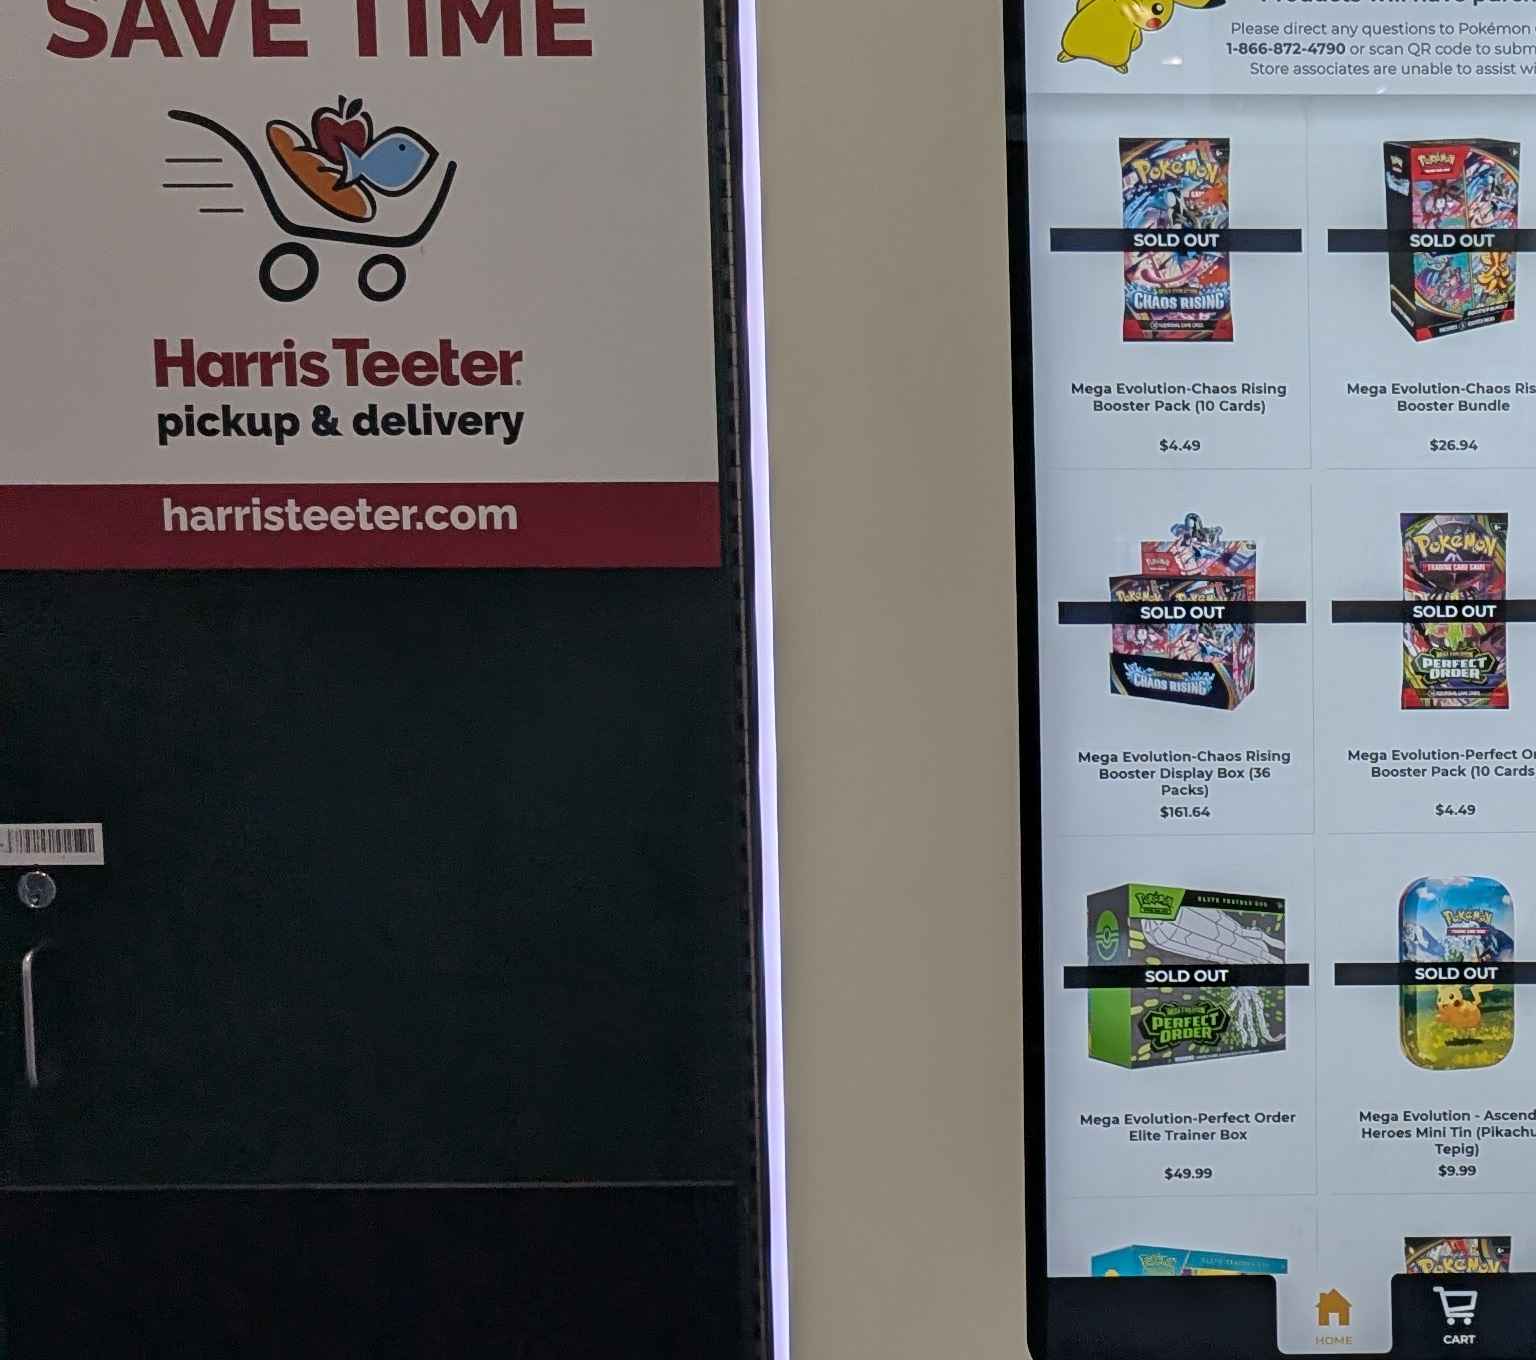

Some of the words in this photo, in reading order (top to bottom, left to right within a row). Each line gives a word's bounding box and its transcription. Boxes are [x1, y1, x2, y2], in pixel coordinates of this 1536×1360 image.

[1231, 21, 1280, 36] Please
[1283, 21, 1328, 36] direct
[1330, 23, 1359, 39] any
[1361, 21, 1436, 38] questions
[1439, 23, 1455, 36] to
[1458, 21, 1531, 36] Pokémon
[1225, 41, 1346, 56] 1-866-872-4790
[1349, 44, 1366, 56] or
[1368, 44, 1404, 56] scan
[1407, 42, 1432, 58] QR
[1434, 41, 1473, 56] code
[1475, 43, 1491, 56] to
[1249, 61, 1290, 76] Store
[1292, 61, 1370, 76] associates
[1373, 64, 1397, 76] are
[1401, 61, 1454, 76] unable
[1455, 63, 1473, 76] to
[1475, 61, 1517, 76] assist
[1133, 233, 1181, 248] SOLD
[1183, 233, 1220, 248] OUT
[1409, 233, 1457, 248] SOLD
[1459, 233, 1496, 248] OUT
[1134, 292, 1178, 310] CHAOS
[1180, 292, 1224, 310] RISING
[153, 338, 330, 388] Harris
[331, 337, 523, 387] Teeter
[1071, 382, 1113, 398] Mega
[1116, 381, 1238, 395] Evolution-Chaos
[1241, 382, 1287, 398] Rising
[1347, 383, 1388, 398] Mega
[1391, 382, 1511, 395] Evolution-Chaos
[1093, 399, 1151, 412] Booster
[1154, 399, 1191, 412] Pack
[1195, 399, 1215, 415] (10
[1218, 399, 1266, 415] Cards)
[1397, 399, 1455, 412] Booster
[1458, 399, 1511, 412] Bundle
[157, 403, 301, 447] pickup
[311, 404, 343, 437] &
[352, 403, 525, 446] delivery
[1159, 438, 1201, 453] $4.49
[1429, 438, 1479, 452] $26.94
[162, 496, 518, 532] harristeeter.com
[1412, 605, 1459, 619] SOLD
[1461, 604, 1497, 618] OUT
[1347, 749, 1388, 764] Mega
[1391, 748, 1518, 761] Evolution-Perfect
[1371, 766, 1428, 778] Booster
[1431, 764, 1467, 777] Pack
[1470, 765, 1491, 780] (10
[1159, 805, 1211, 819] $161.64
[1435, 803, 1476, 817] $4.49
[1414, 967, 1460, 980] SOLD
[1463, 966, 1499, 980] OUT
[1438, 1164, 1477, 1178] $9.99
[1315, 1335, 1353, 1345] HOME
[1442, 1334, 1477, 1345] CART
